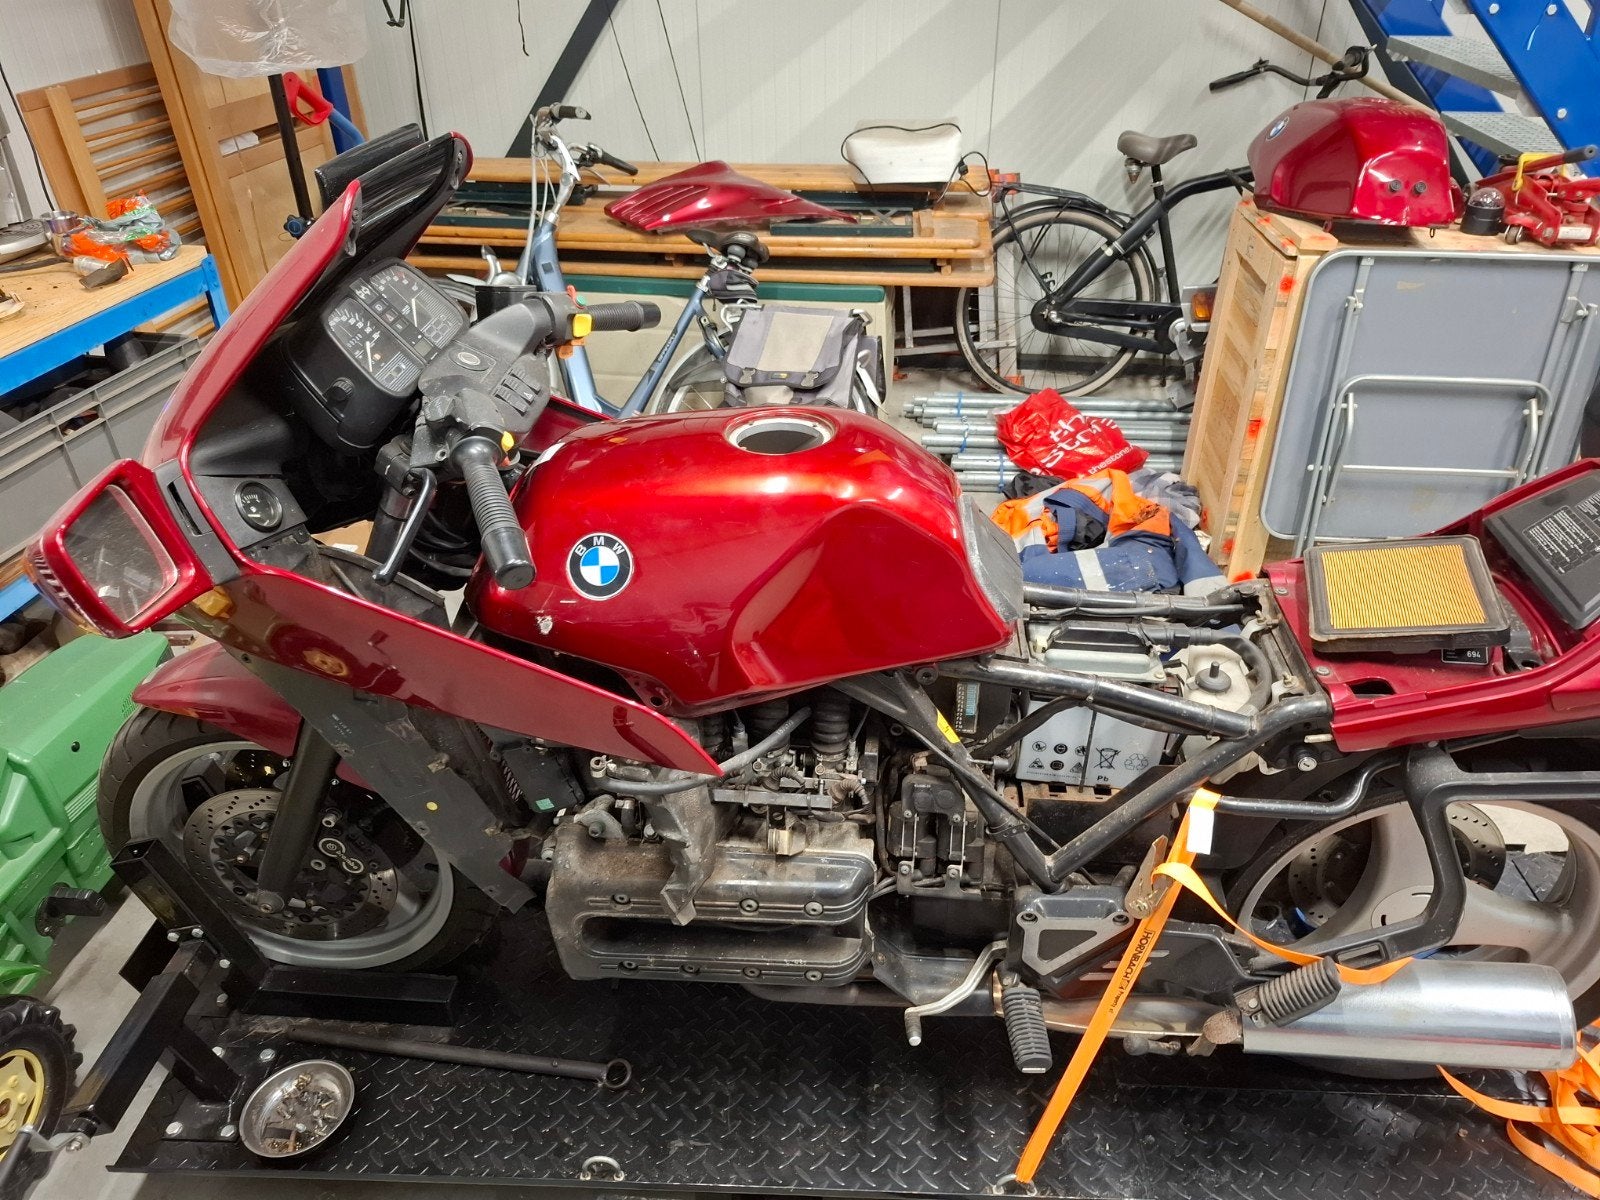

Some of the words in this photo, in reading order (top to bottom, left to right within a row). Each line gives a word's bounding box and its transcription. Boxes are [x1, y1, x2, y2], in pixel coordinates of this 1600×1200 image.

[575, 536, 625, 557] BMW
[1466, 650, 1481, 658] 694
[336, 850, 359, 870] brembo
[1123, 930, 1153, 980] HORNBACH
